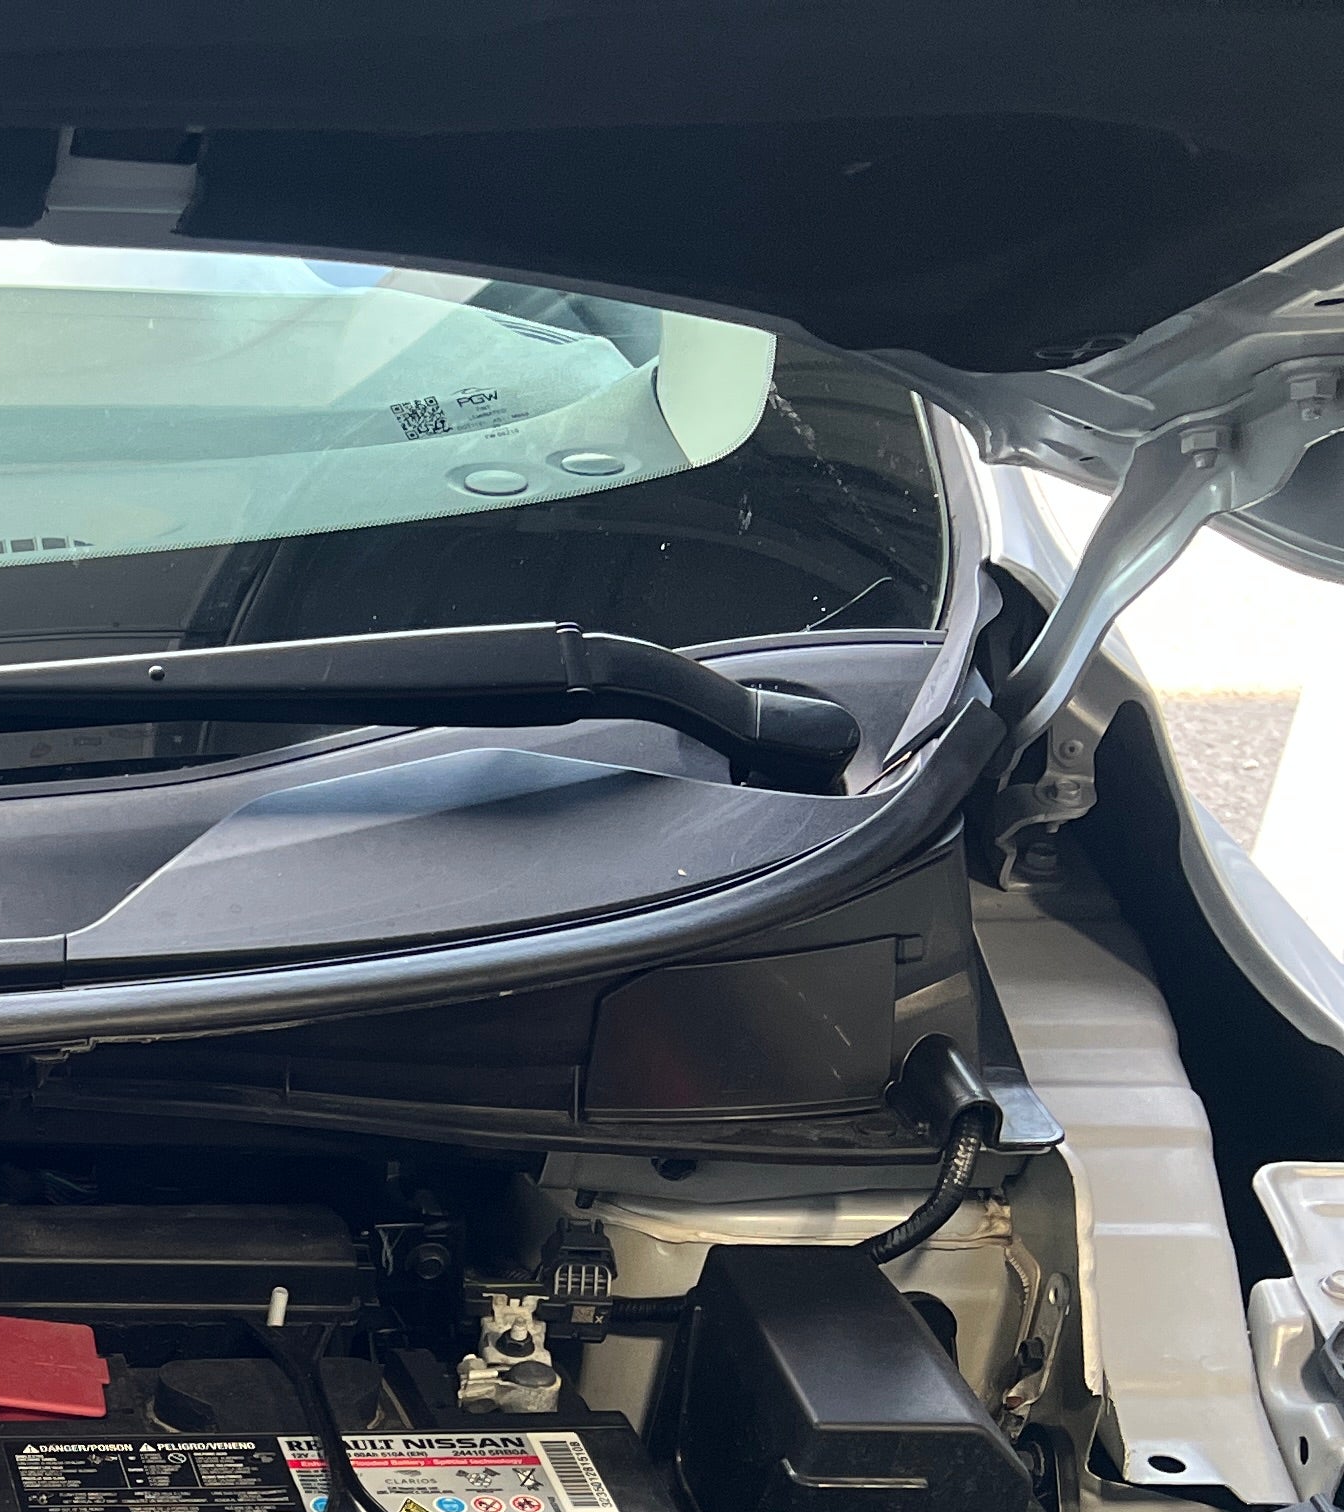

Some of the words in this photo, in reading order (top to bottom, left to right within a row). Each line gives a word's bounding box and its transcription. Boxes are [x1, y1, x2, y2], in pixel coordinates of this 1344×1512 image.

[457, 390, 498, 408] PGW
[39, 1444, 133, 1453] DANGER/POISON
[157, 1442, 255, 1451] PELIGRO/VENENO
[286, 1438, 393, 1451] REAULT
[402, 1437, 525, 1449] NISSAN
